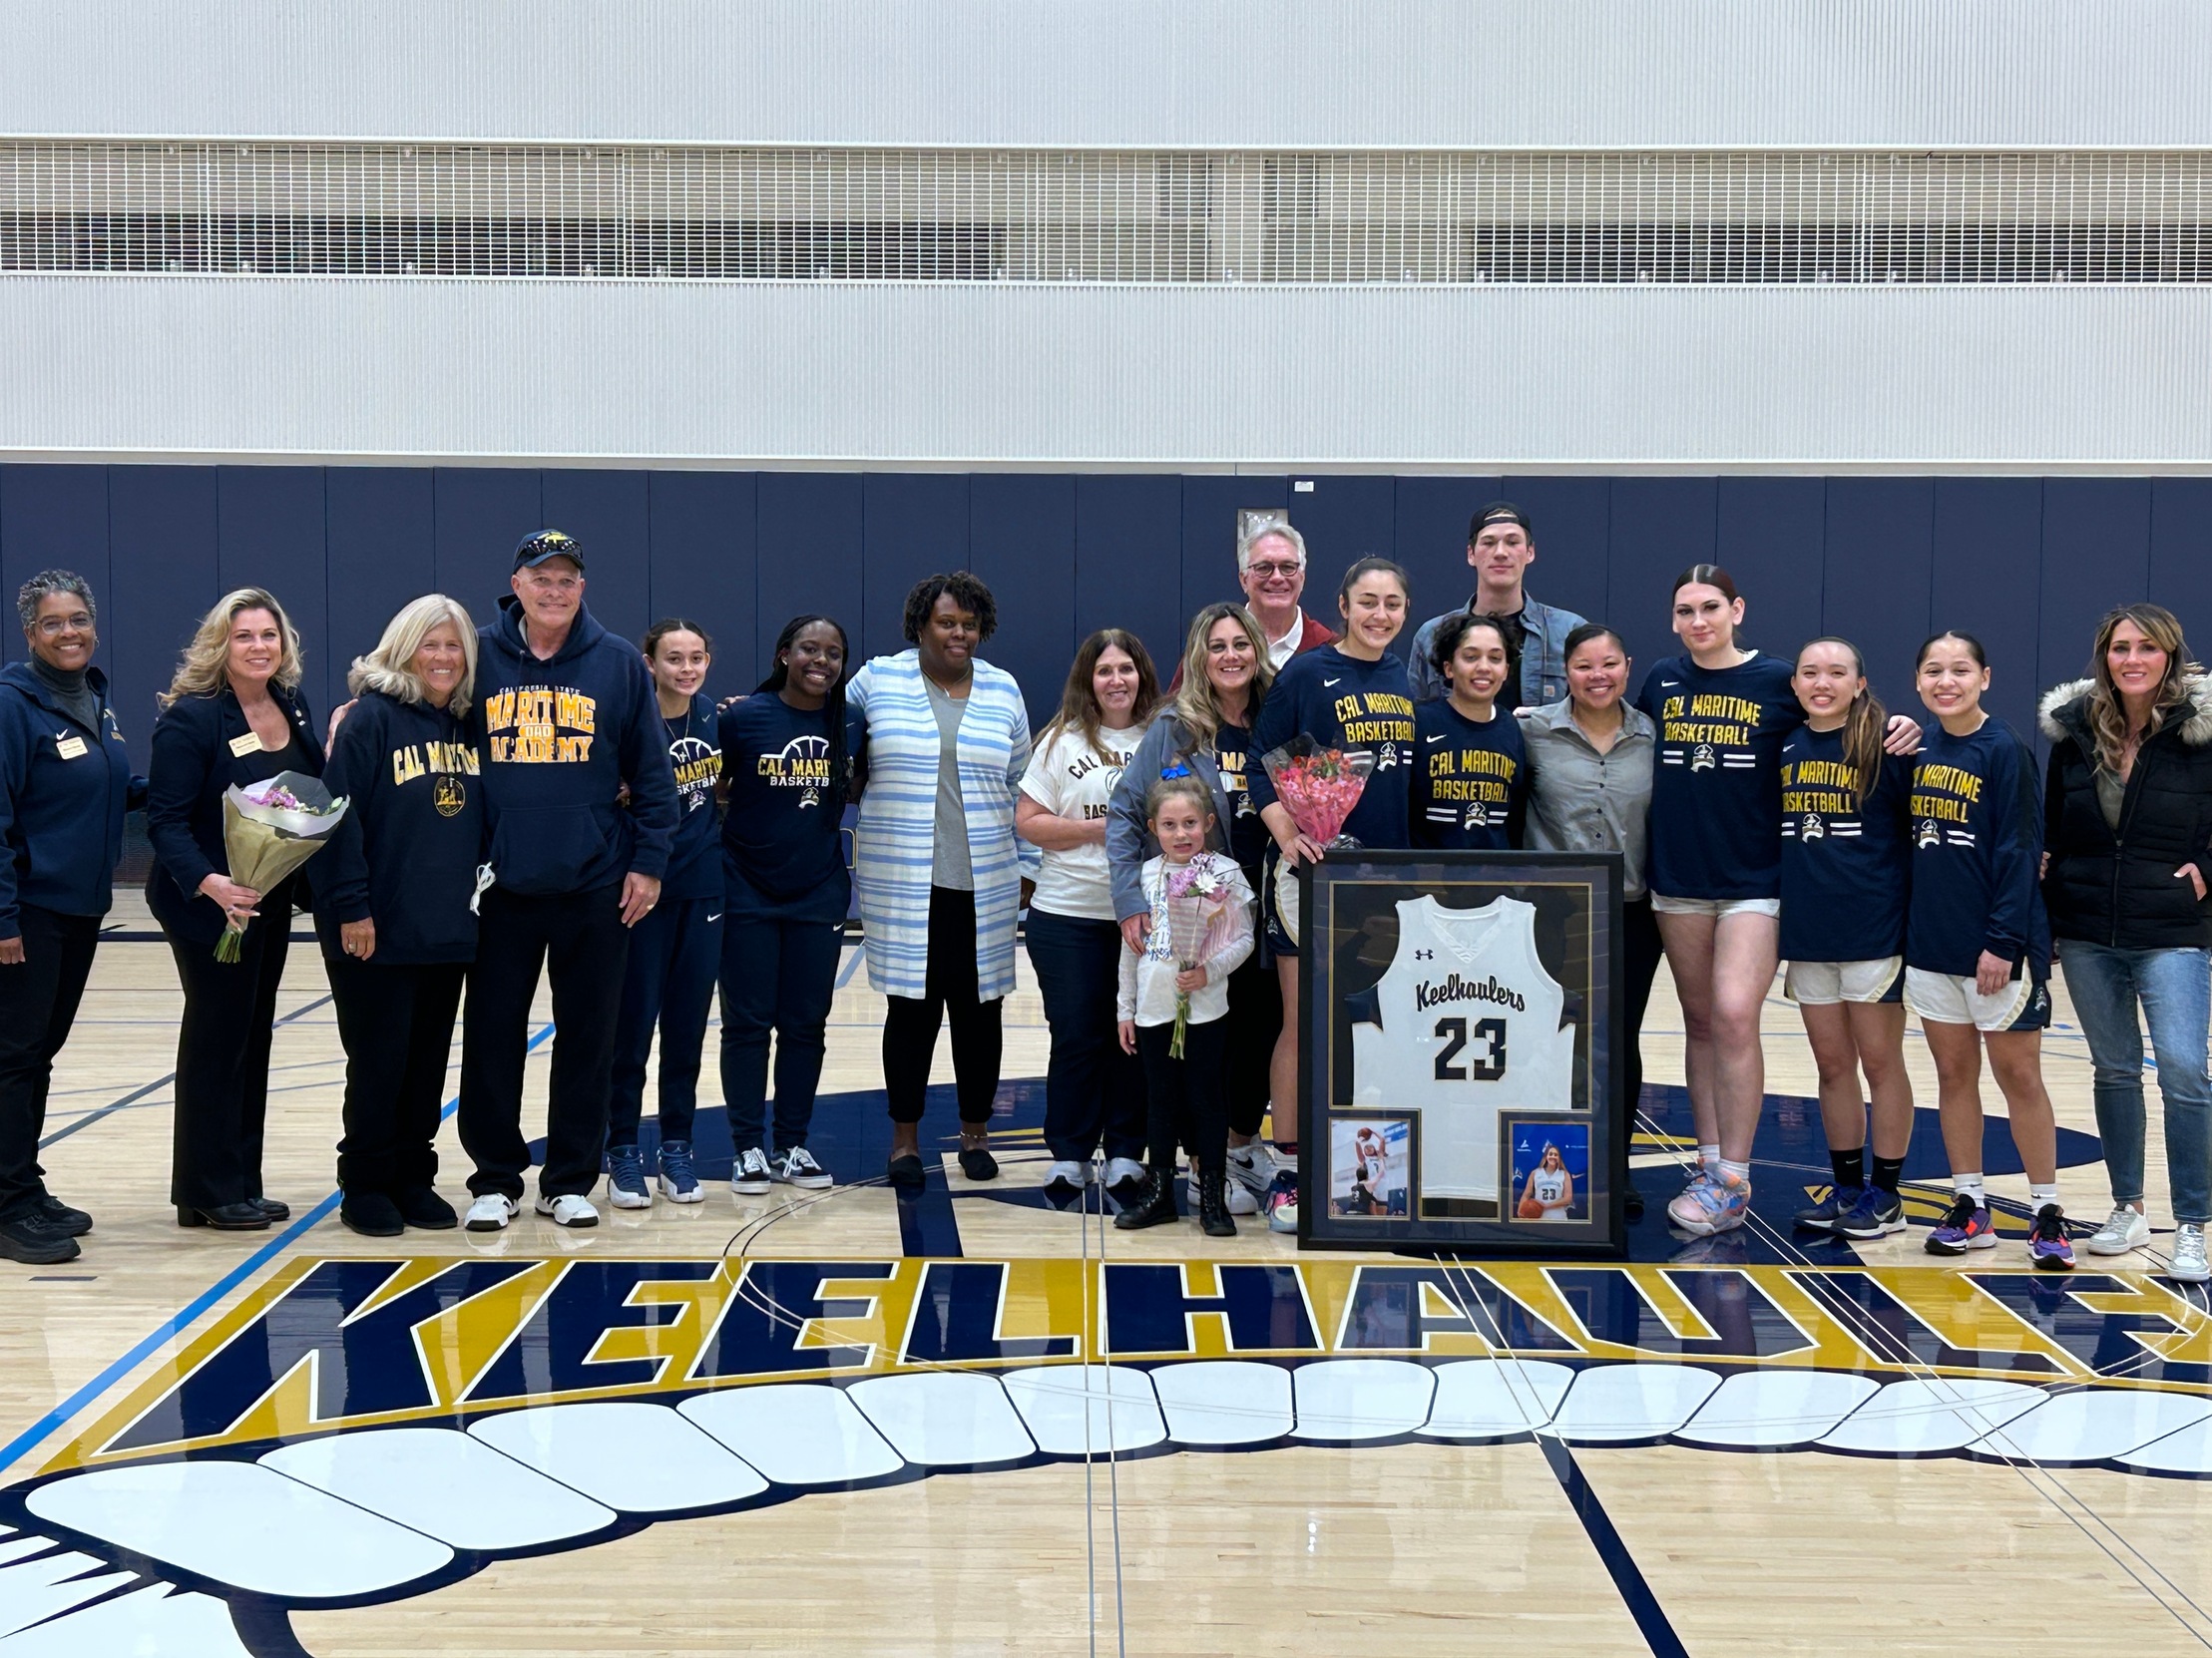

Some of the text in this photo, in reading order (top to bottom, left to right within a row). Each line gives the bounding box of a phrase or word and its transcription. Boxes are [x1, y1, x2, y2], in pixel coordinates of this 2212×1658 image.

[486, 690, 596, 734] MARITIME
[1334, 694, 1364, 722] CAL
[1662, 693, 1762, 727] CAL MARITIME
[1664, 721, 1750, 746] BASKETBALL
[393, 744, 426, 786] CAL
[490, 736, 594, 763] ACADEMY
[1429, 750, 1456, 778] CAL
[757, 758, 831, 777] CAL MARI
[1068, 754, 1099, 780] CAL
[1920, 763, 1984, 803] MARITIME
[1415, 973, 1526, 1013] Keelhaulers
[1434, 1017, 1507, 1081] 23
[1542, 1188, 1556, 1201] 23
[92, 1259, 2212, 1457] KEELHAULE
